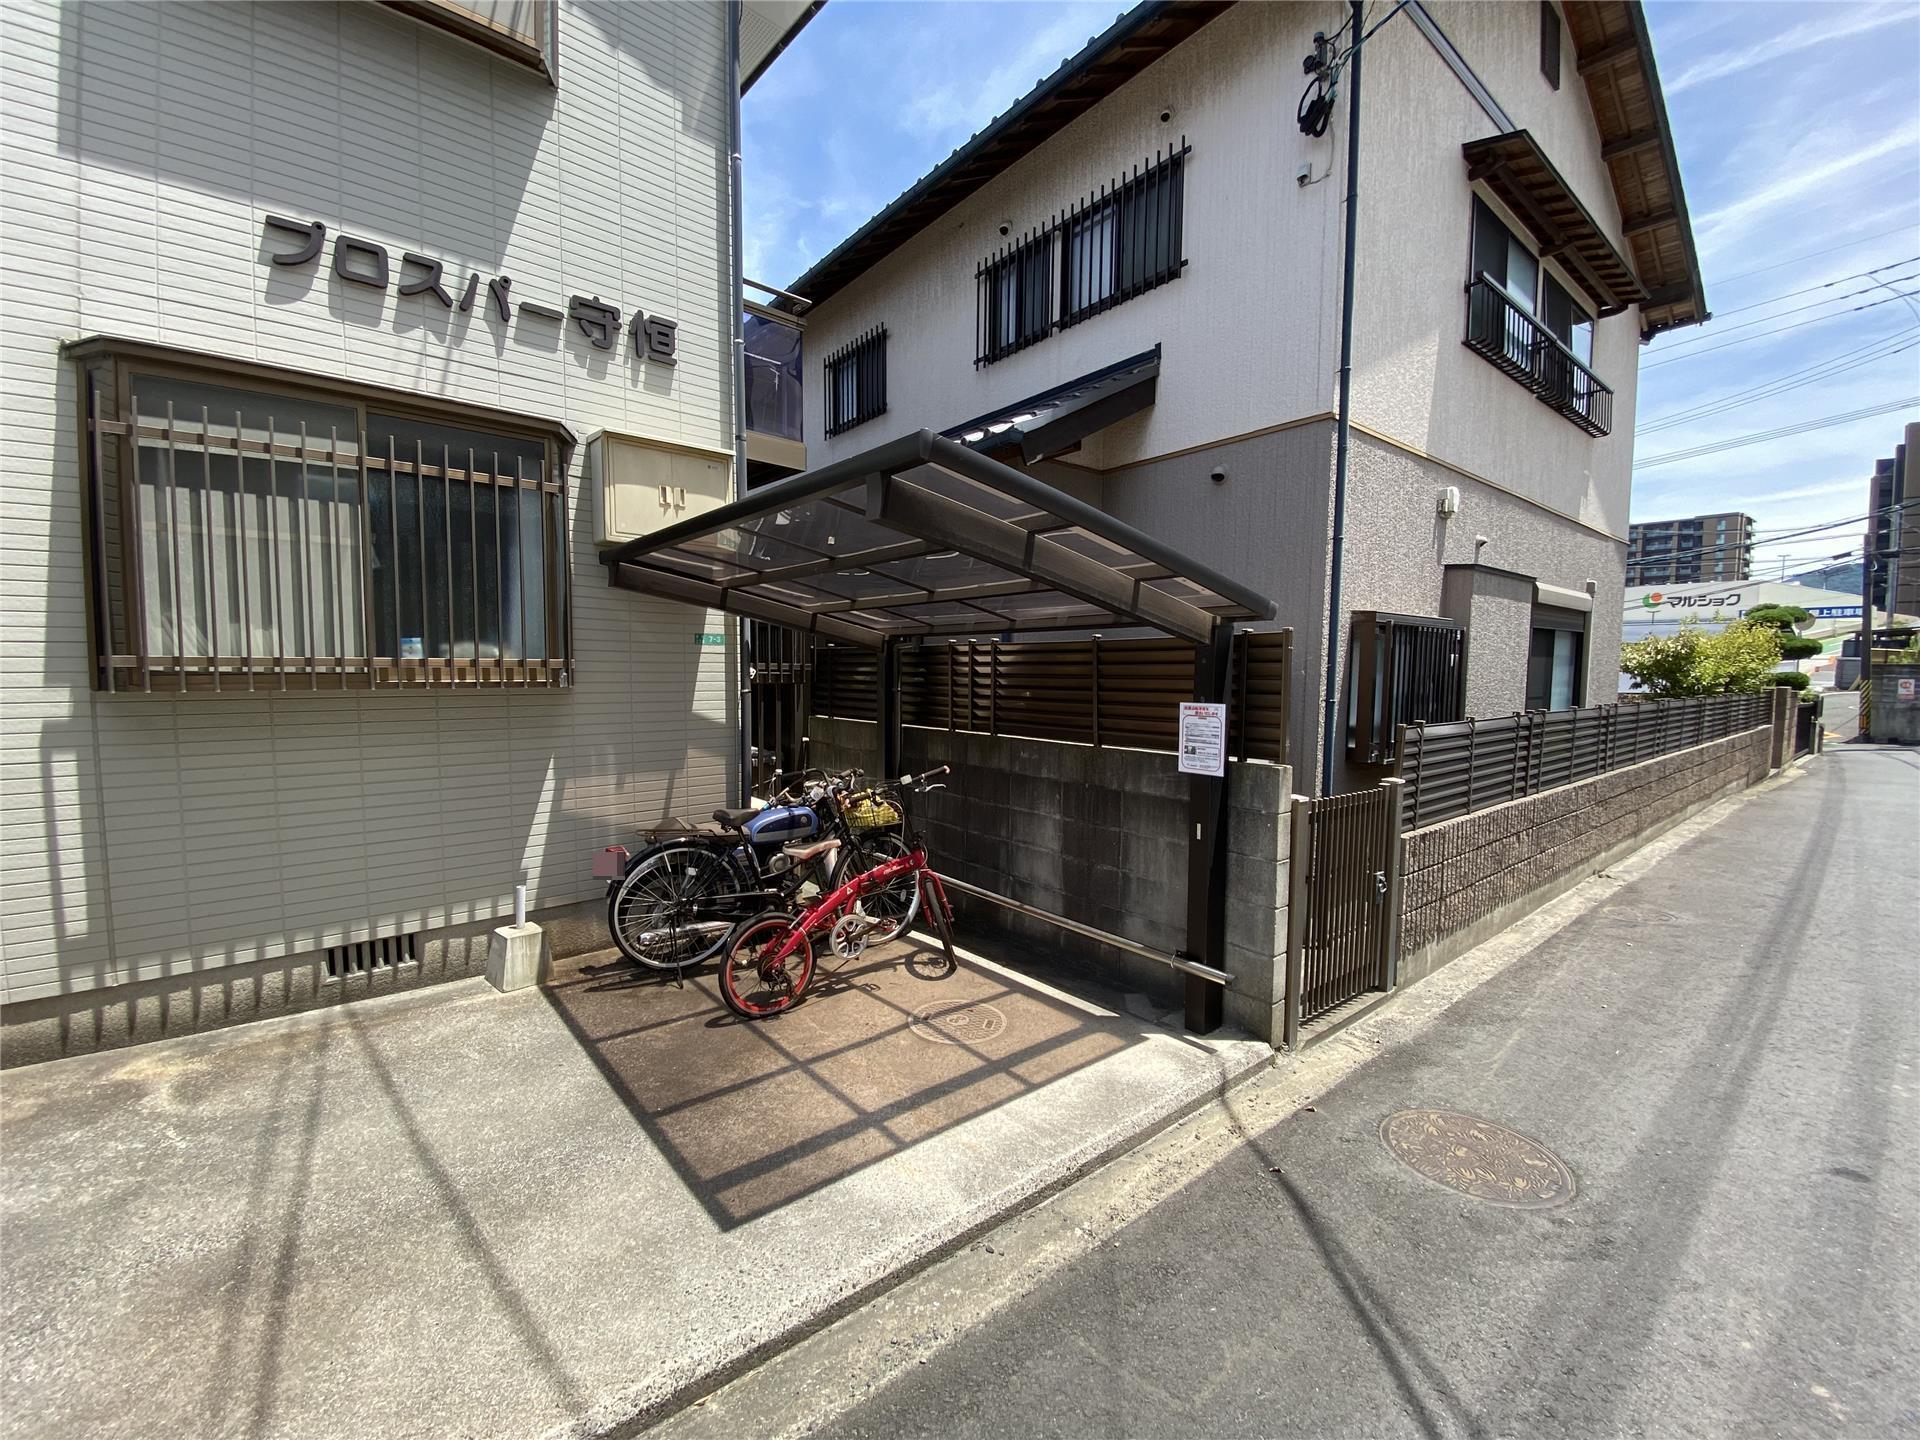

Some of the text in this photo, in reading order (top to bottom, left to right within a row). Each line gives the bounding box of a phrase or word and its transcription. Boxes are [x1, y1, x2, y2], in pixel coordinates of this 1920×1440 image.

[265, 214, 678, 366] プロスパー守恒
[1667, 594, 1741, 608] マルショク
